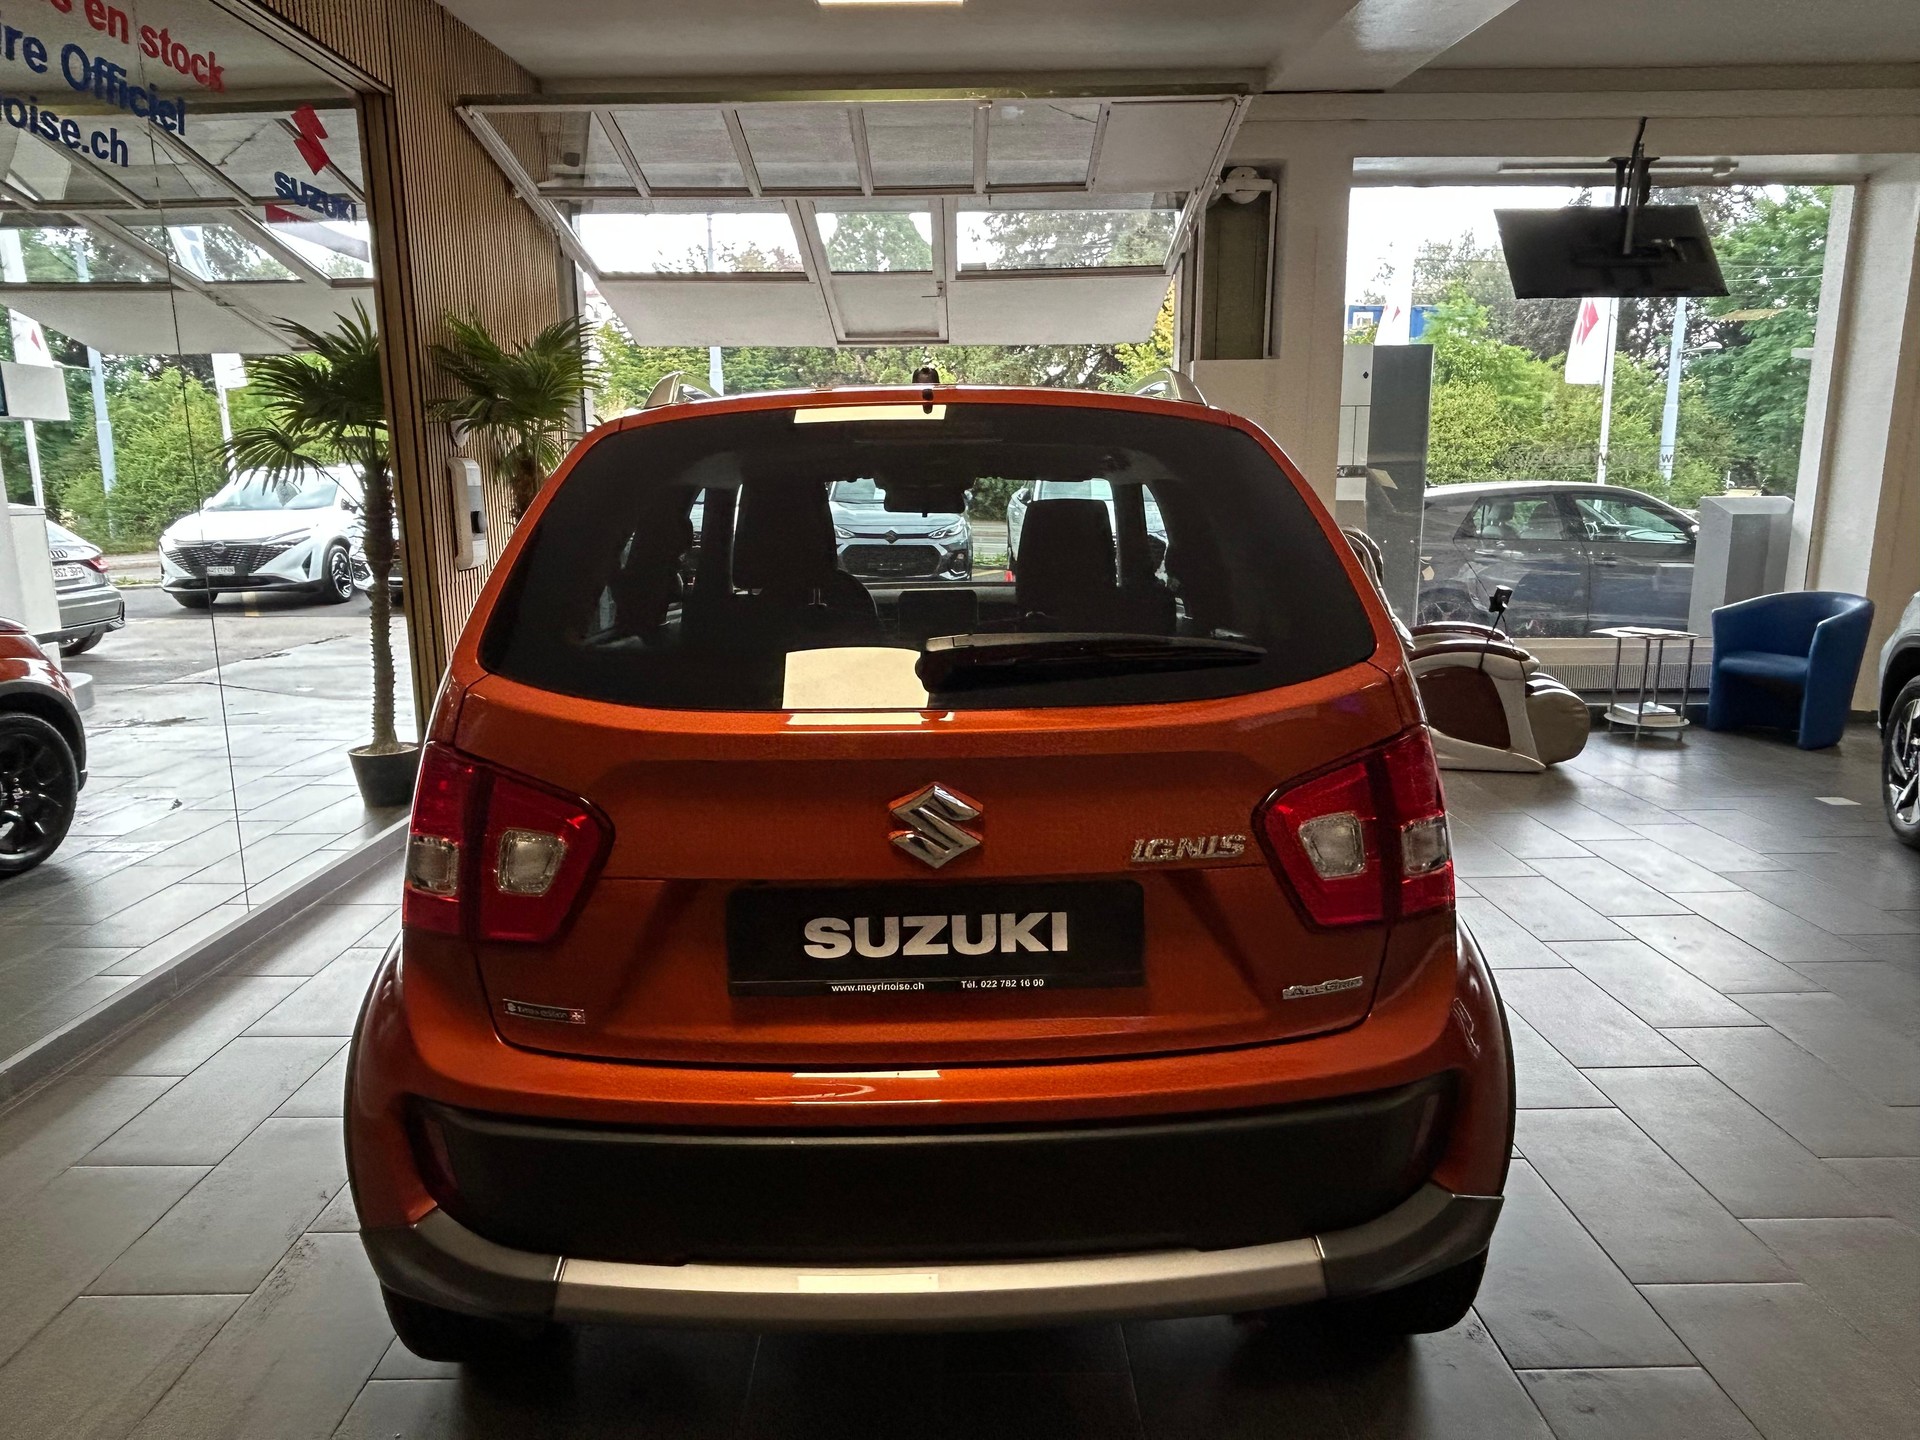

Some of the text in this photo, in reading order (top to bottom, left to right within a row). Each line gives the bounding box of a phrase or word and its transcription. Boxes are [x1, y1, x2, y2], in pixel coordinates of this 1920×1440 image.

[84, 0, 225, 93] en stock
[0, 22, 186, 136] re Officiel
[0, 95, 129, 167] oise.ch
[274, 171, 358, 226] SUZUKI
[1131, 834, 1247, 863] IGNIS
[803, 911, 1069, 960] SUZUKI
[831, 982, 925, 993] www.meyrinoise.ch
[980, 979, 998, 988] 022
[1000, 979, 1017, 988] 782
[1032, 978, 1045, 988] 00
